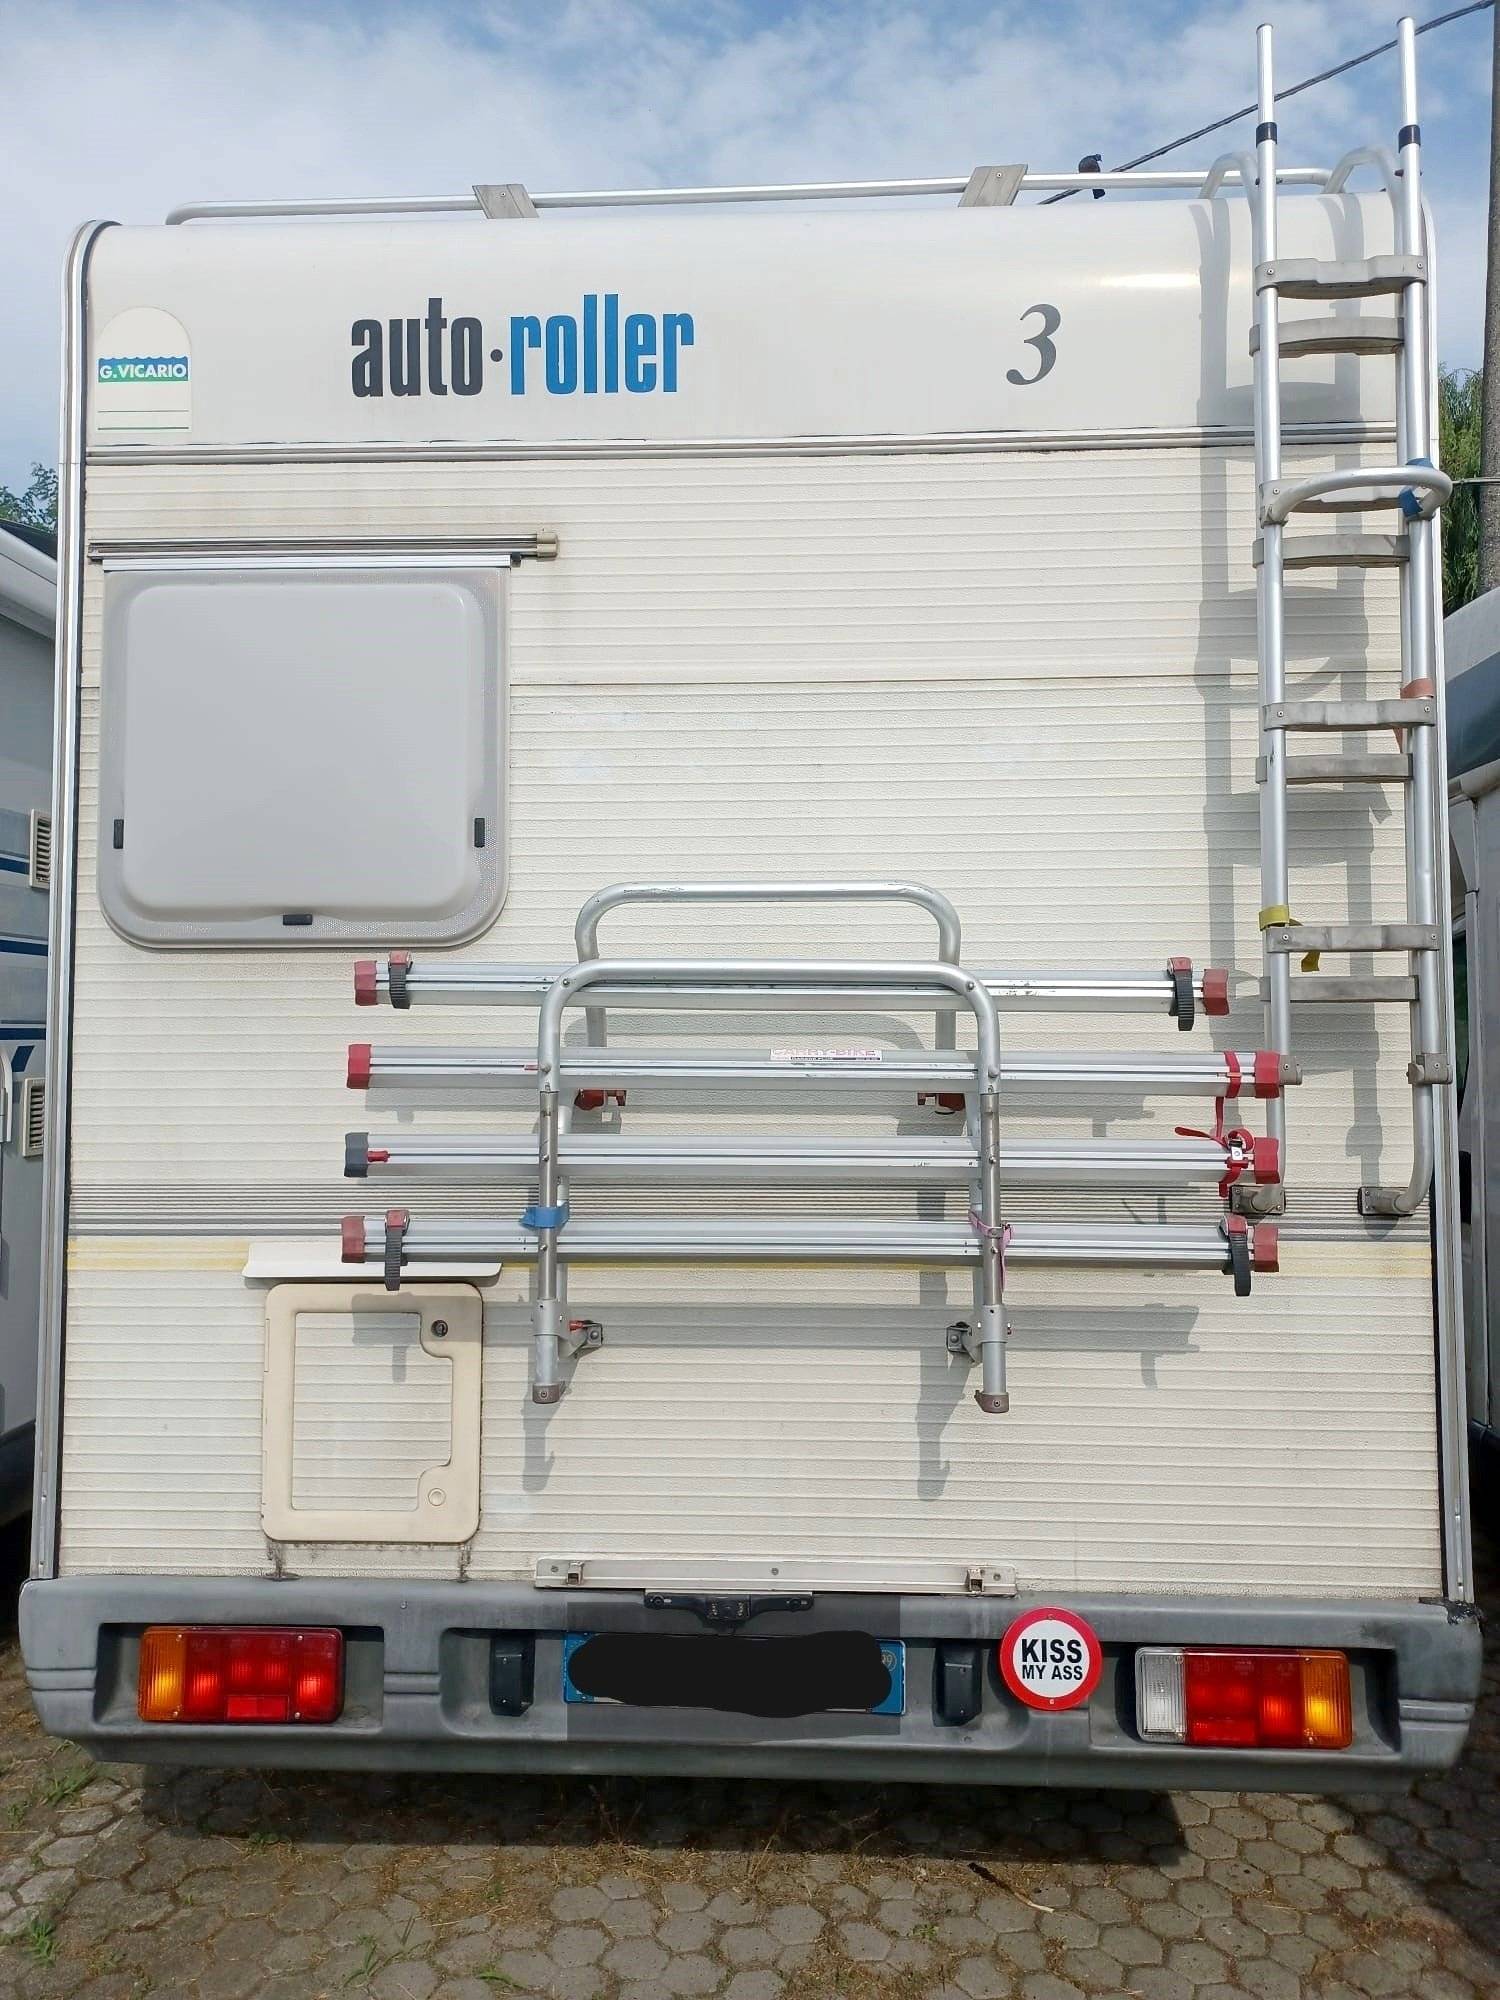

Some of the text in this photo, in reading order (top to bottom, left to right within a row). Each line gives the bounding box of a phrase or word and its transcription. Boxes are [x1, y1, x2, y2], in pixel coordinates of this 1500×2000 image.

[1006, 303, 1061, 385] 3
[99, 363, 187, 379] G.VICARIO
[1021, 1638, 1083, 1664] KISS
[1022, 1665, 1083, 1681] MY ASS
